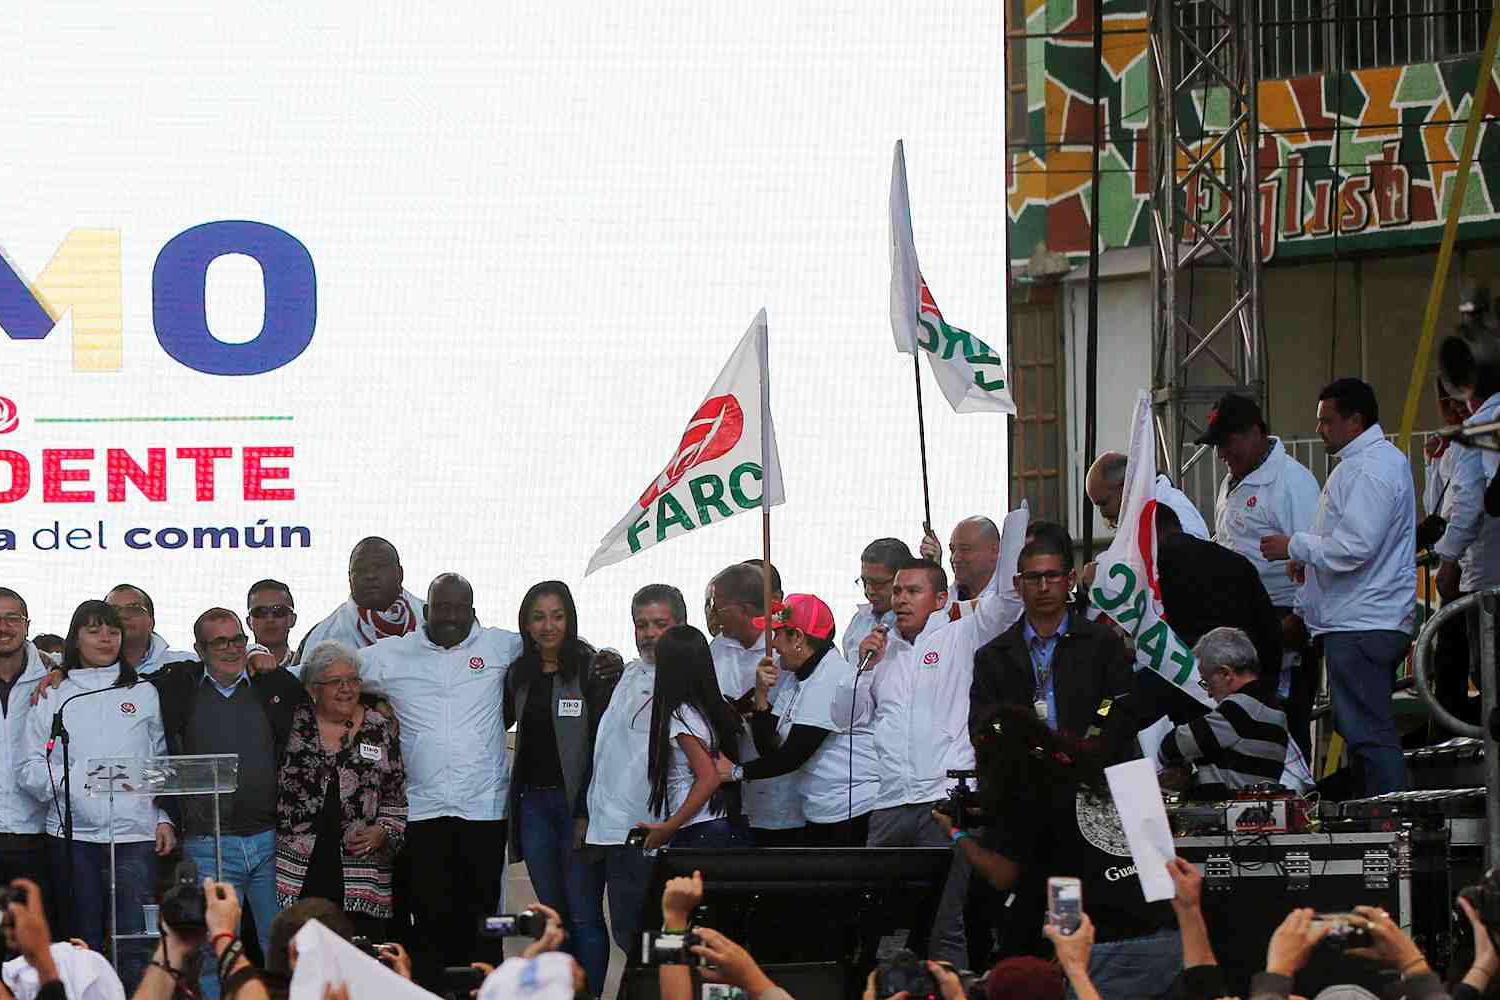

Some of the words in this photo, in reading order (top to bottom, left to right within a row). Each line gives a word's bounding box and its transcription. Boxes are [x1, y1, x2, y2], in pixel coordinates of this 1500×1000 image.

[1183, 141, 1412, 263] Eglish
[32, 520, 107, 551] del
[124, 519, 311, 550] común
[627, 462, 764, 553] FARC
